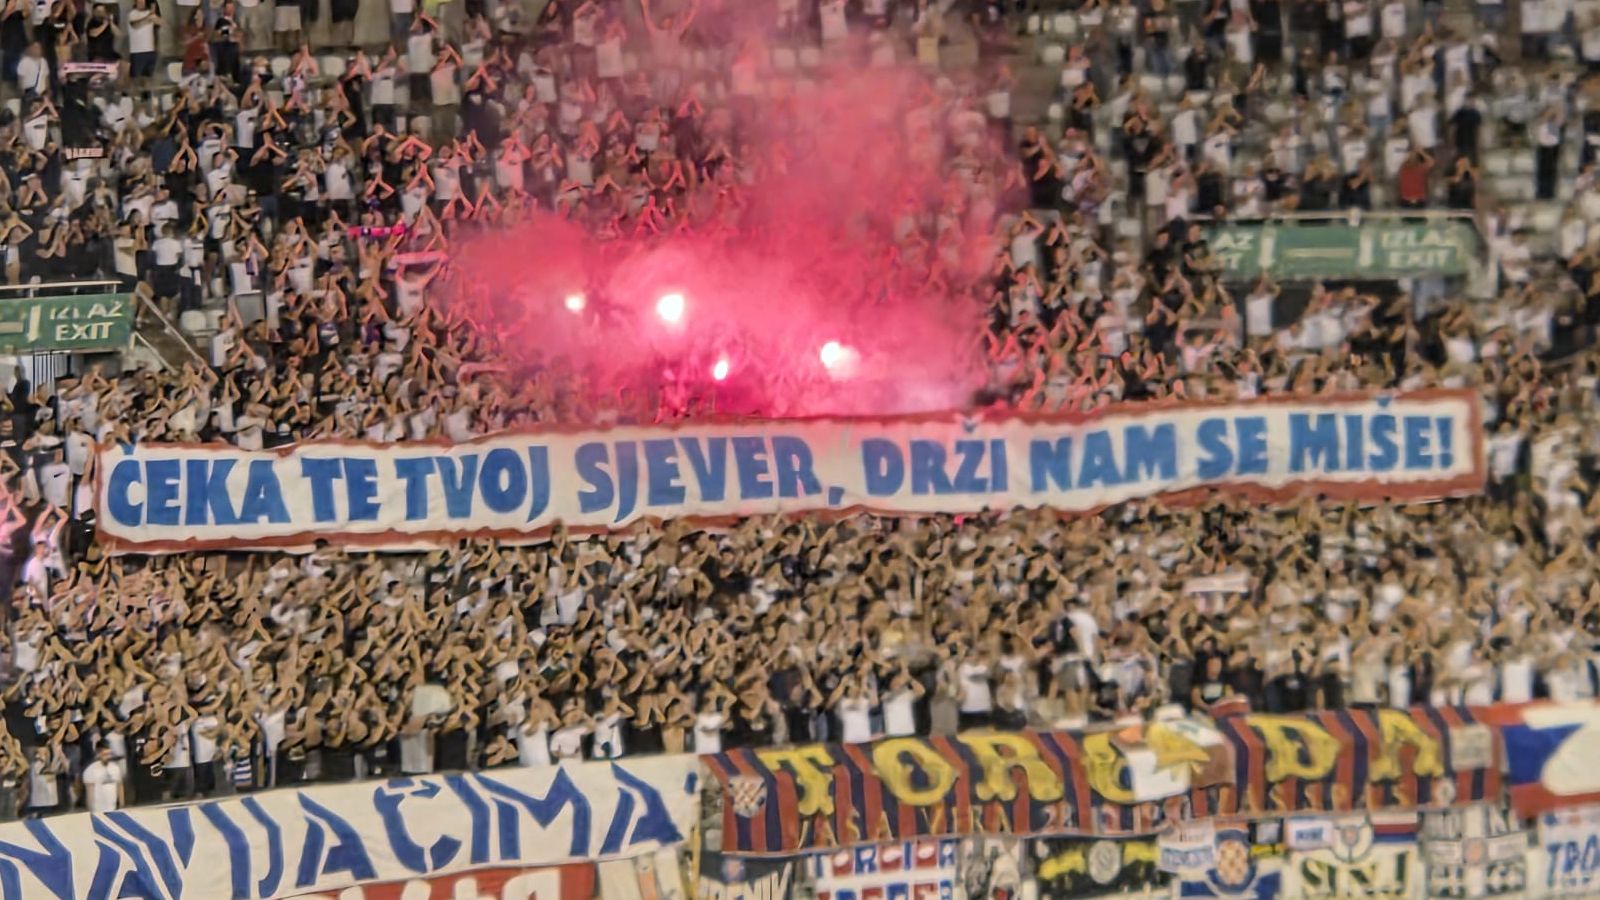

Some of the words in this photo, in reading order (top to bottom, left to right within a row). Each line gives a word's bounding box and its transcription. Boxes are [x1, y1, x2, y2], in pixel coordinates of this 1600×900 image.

[1388, 249, 1449, 268] EXIT
[55, 321, 114, 342] EXIT
[107, 442, 292, 527] ČEKA
[301, 456, 382, 523] TE
[394, 445, 551, 523] TVOJ
[573, 435, 845, 523] SJEVER,
[861, 414, 1009, 497] DRŽI
[1029, 423, 1179, 492] NAM
[1196, 416, 1270, 479] SE
[1288, 396, 1454, 473] MIŠE!
